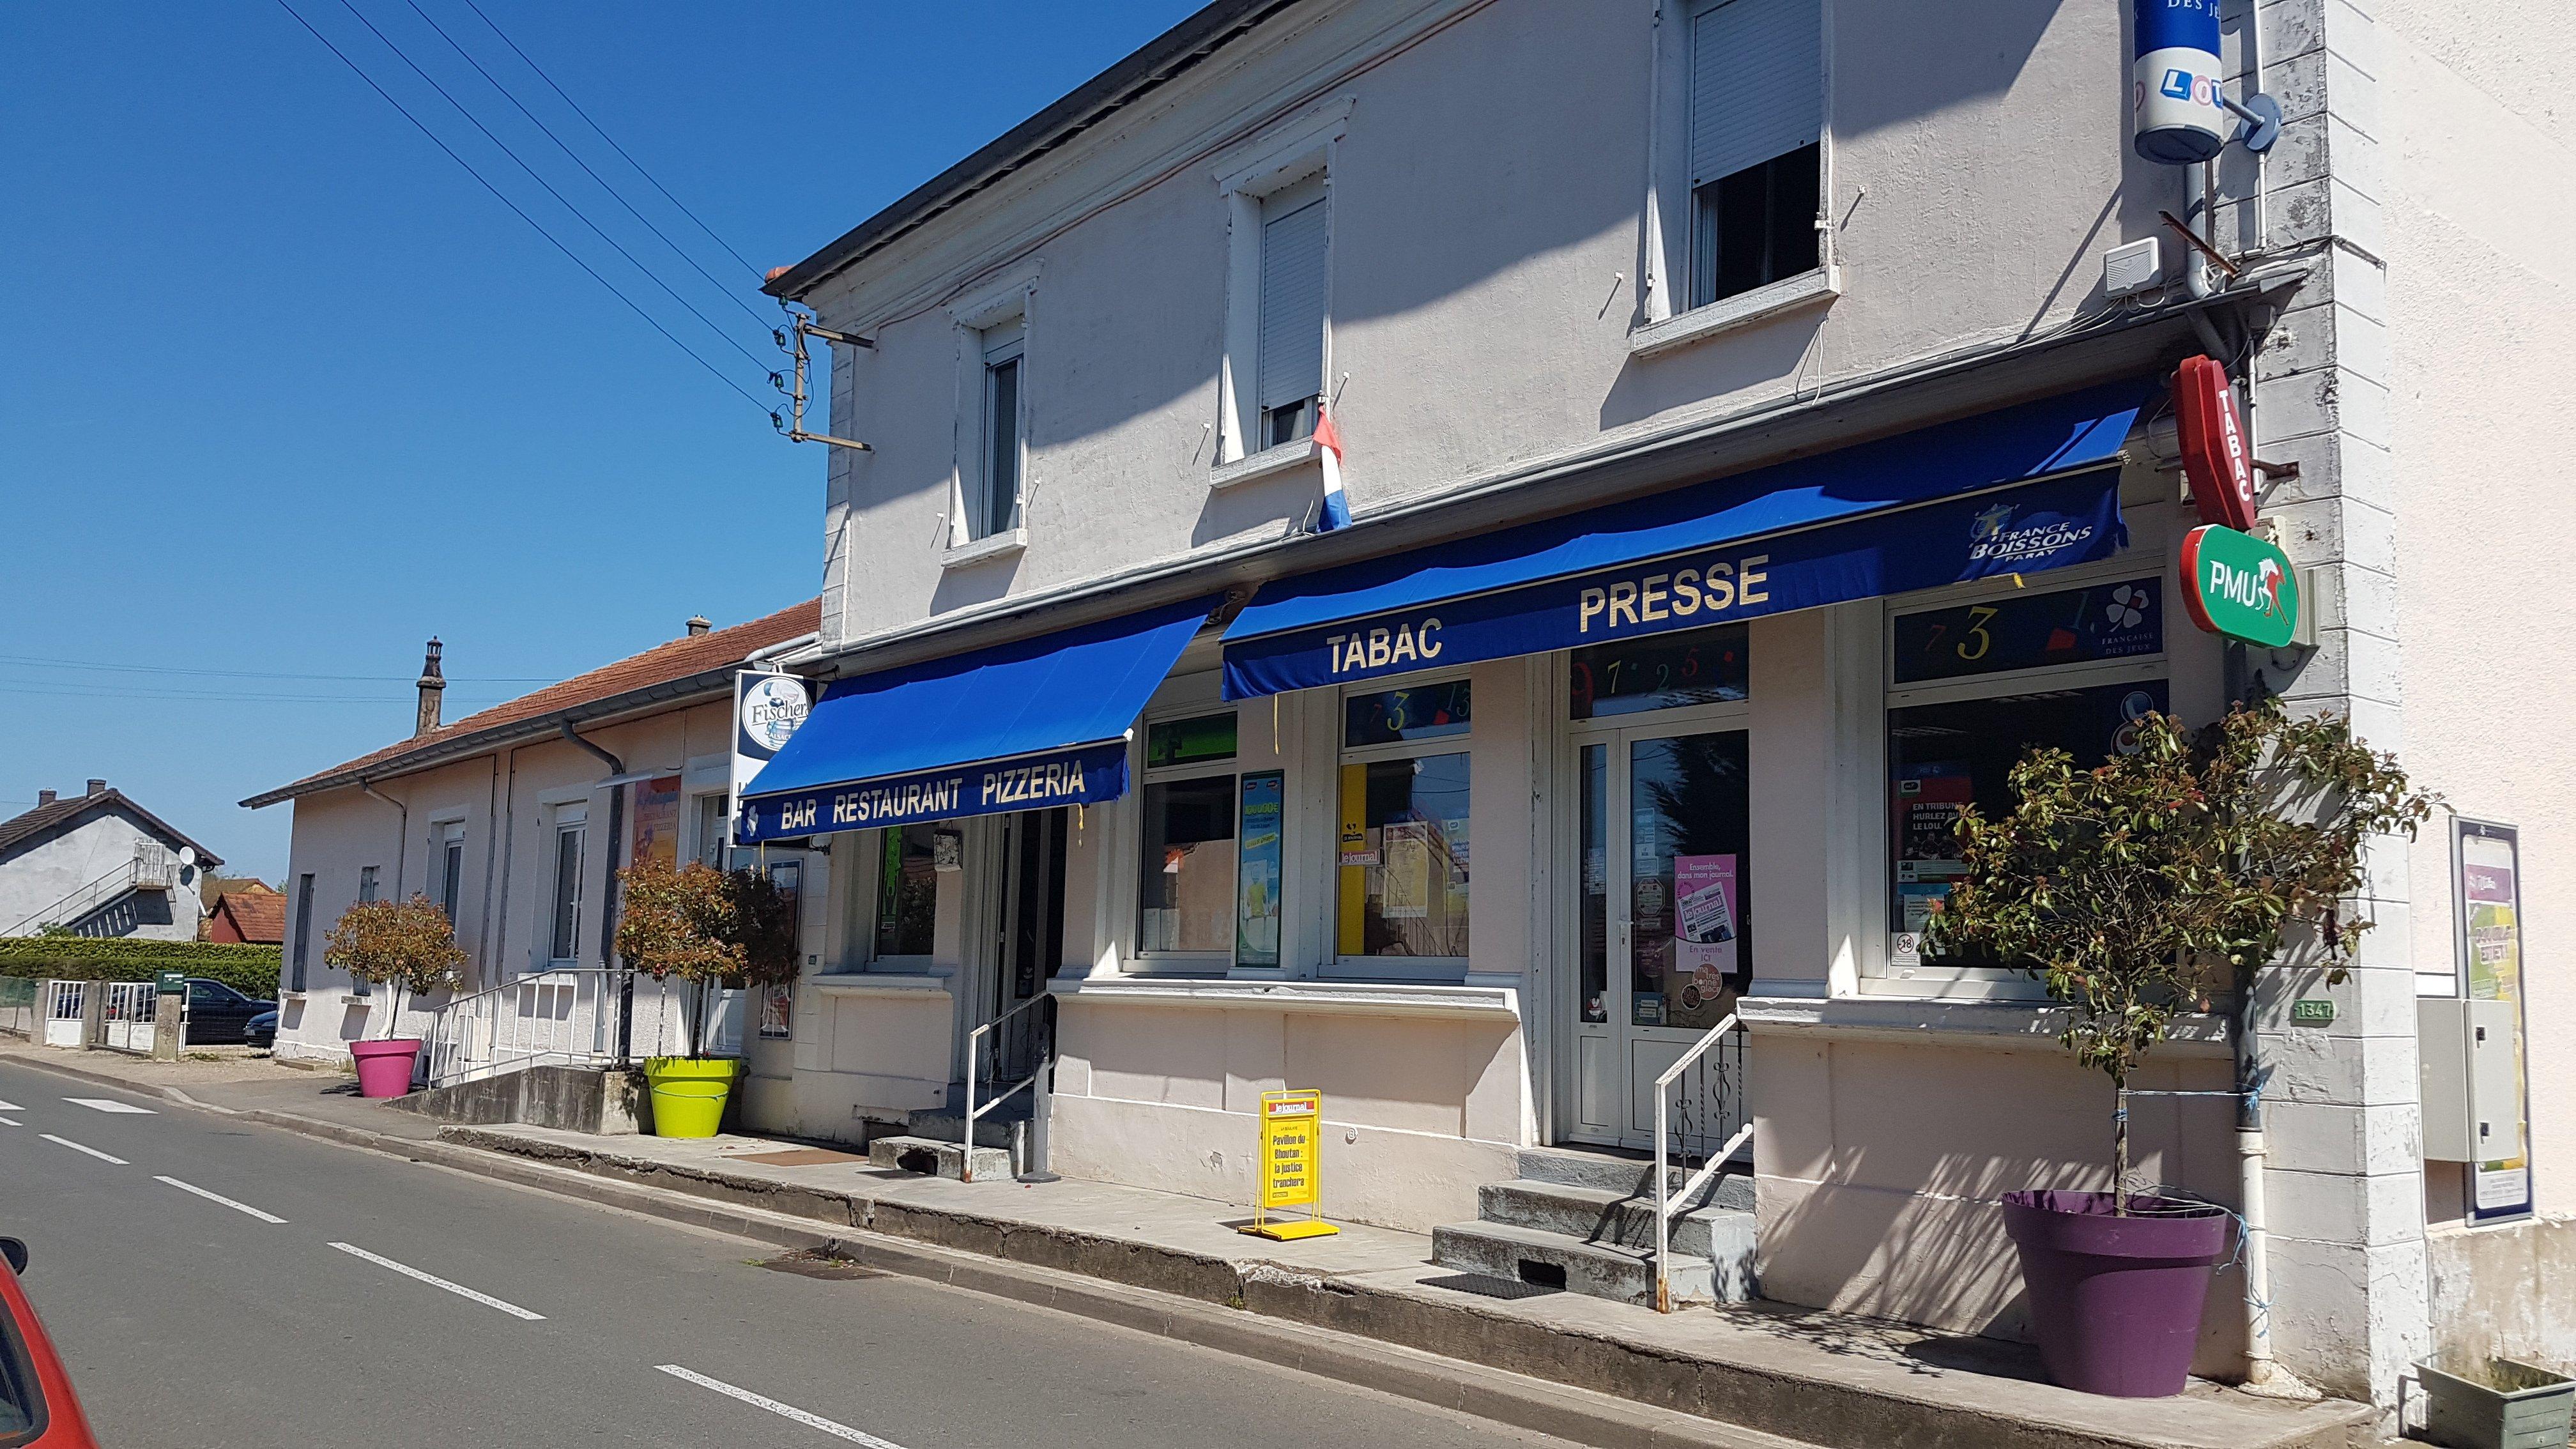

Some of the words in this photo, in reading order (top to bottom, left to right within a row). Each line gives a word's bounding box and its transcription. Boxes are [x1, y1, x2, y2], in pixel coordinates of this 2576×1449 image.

[2160, 68, 2222, 109] LOT
[2219, 390, 2250, 502] TABAC
[1999, 522, 2071, 542] FRANCE
[1969, 526, 2092, 560] BOISSONS
[2005, 549, 2057, 562] PARAY
[1580, 554, 1769, 632] PRESSE
[2209, 560, 2258, 607] PMU
[1326, 617, 1442, 673] TABAC
[751, 701, 807, 724] Fischer
[781, 799, 816, 829] BAR
[833, 778, 962, 823] RESTAURANT
[982, 760, 1085, 805] PIZZERIA
[1926, 802, 1961, 810] TRIBUN
[1677, 871, 1692, 879] dans
[2298, 1003, 2331, 1016] 1347
[1273, 1135, 1296, 1146] Pavillon
[1298, 1134, 1305, 1144] du
[1275, 1149, 1300, 1159] Bhoutan
[1275, 1163, 1280, 1174] la
[1281, 1162, 1303, 1175] justice
[1273, 1177, 1305, 1188] tranchera
